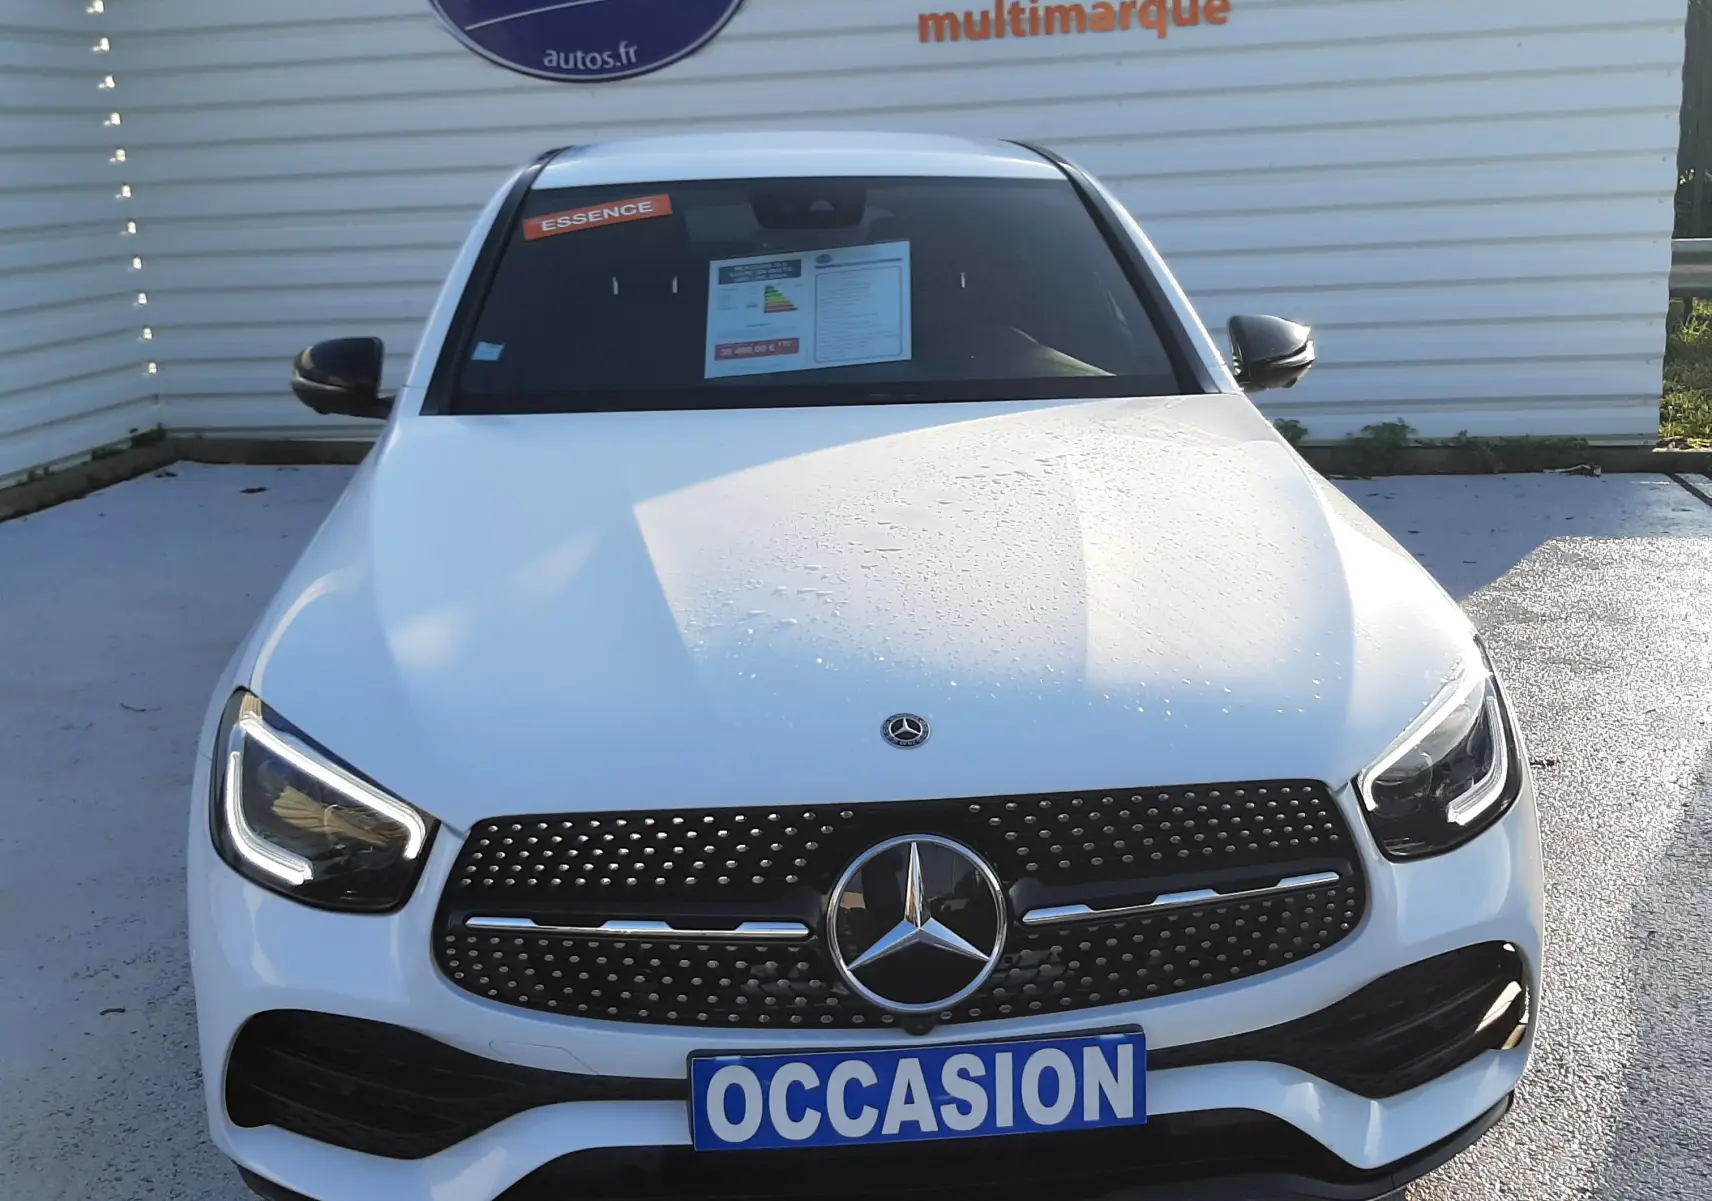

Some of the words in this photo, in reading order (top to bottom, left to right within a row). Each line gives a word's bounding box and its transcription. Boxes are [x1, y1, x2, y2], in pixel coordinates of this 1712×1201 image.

[918, 0, 1231, 43] multimarque
[543, 41, 638, 70] autos.fr
[541, 201, 653, 231] ESSENCE
[706, 1043, 1134, 1143] OCCASION
